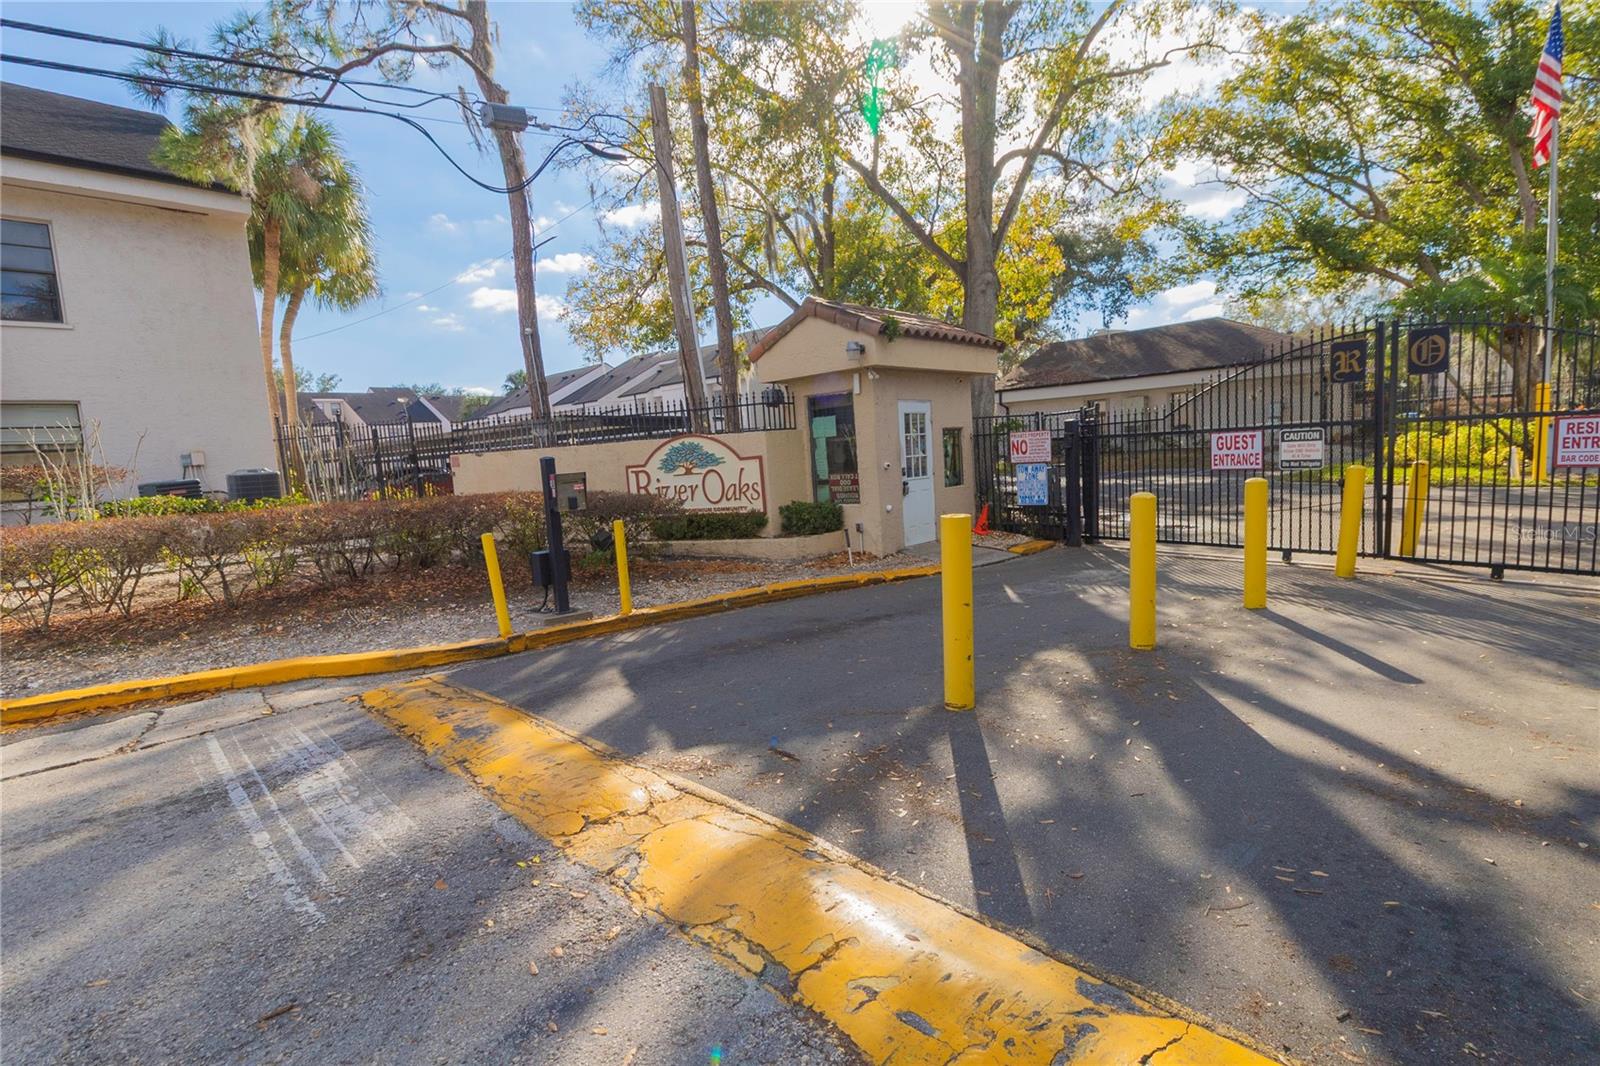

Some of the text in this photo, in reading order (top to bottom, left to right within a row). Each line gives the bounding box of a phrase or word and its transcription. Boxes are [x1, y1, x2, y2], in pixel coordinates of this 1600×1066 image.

[1411, 335, 1446, 367] O
[1332, 349, 1363, 380] R
[1216, 434, 1256, 451] GUEST
[1283, 431, 1320, 441] CAUTION
[1011, 439, 1028, 455] NO
[1213, 453, 1260, 466] ENTRANCE
[1578, 454, 1599, 462] CODE
[1018, 464, 1045, 473] TOW AWAY
[1024, 472, 1039, 480] ZONE
[630, 467, 760, 504] River Oaks
